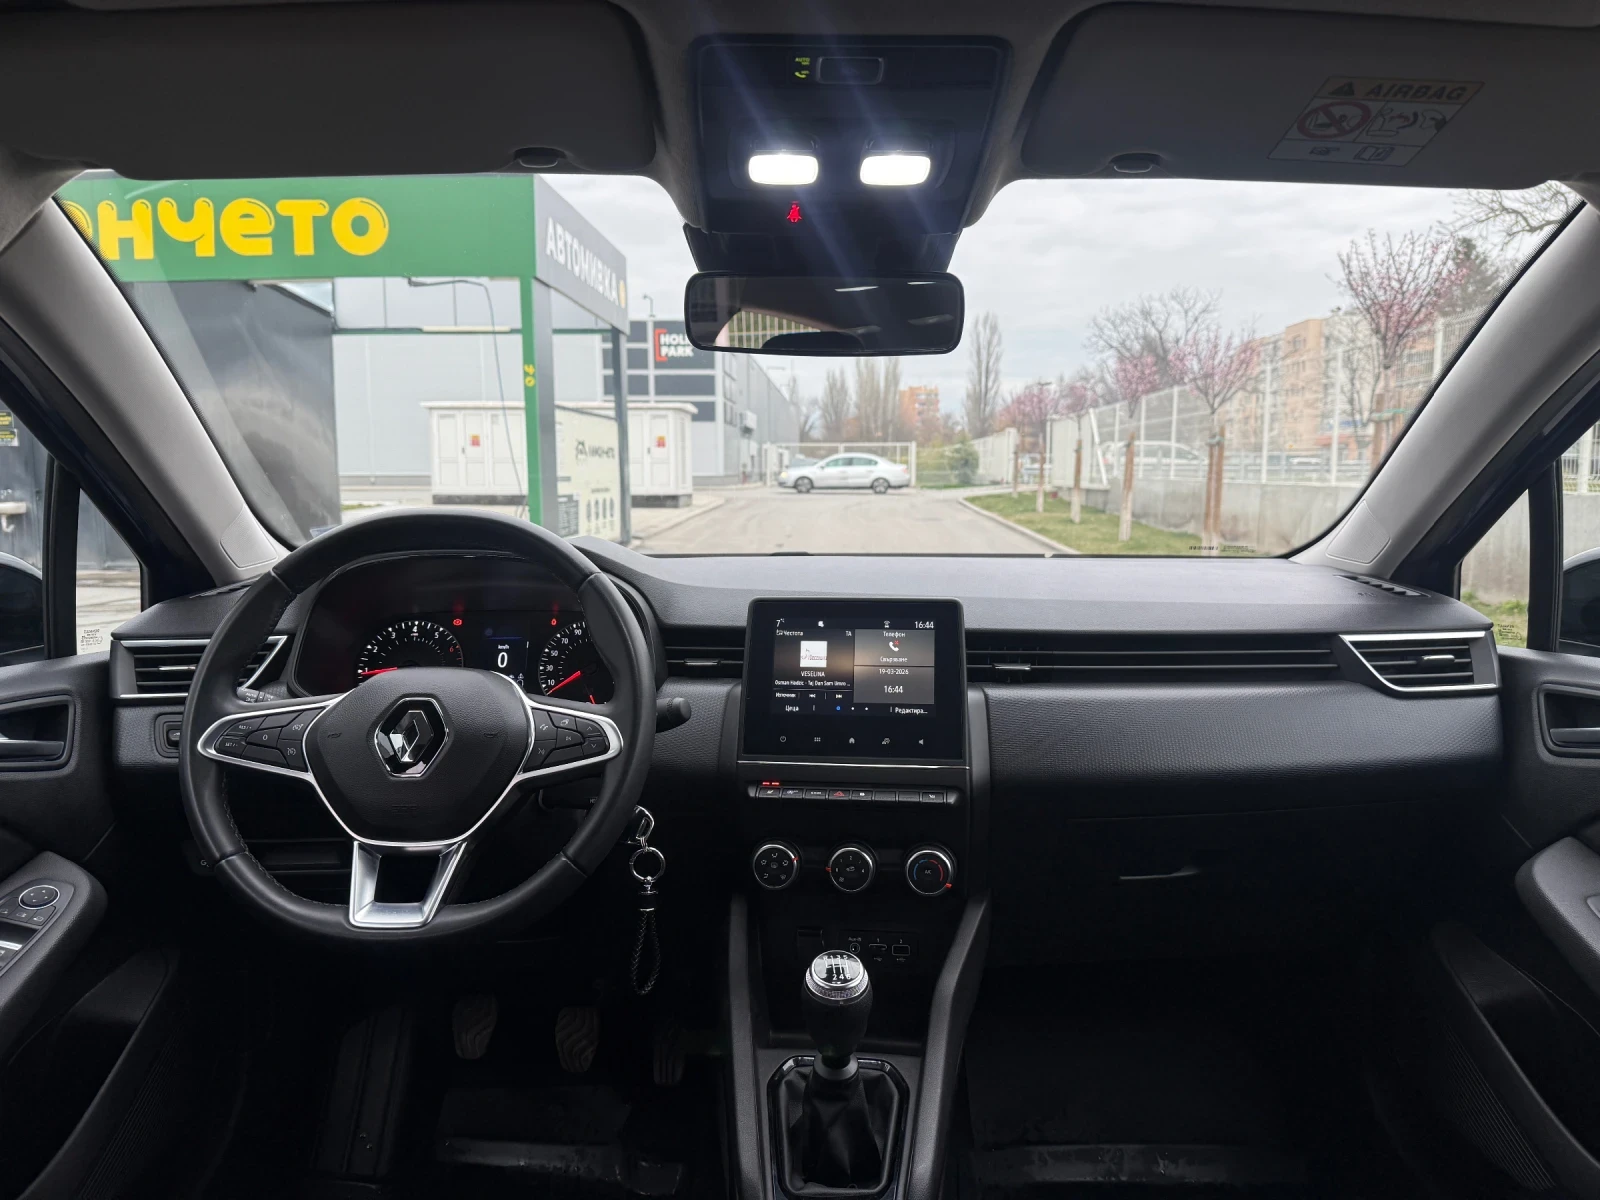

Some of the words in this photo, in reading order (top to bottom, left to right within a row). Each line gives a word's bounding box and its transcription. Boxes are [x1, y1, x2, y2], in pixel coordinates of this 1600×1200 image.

[1365, 83, 1467, 100] AIRBAG
[61, 197, 389, 260] нчето
[660, 346, 694, 357] PARK
[914, 621, 934, 629] 16:44
[497, 652, 508, 668] 0
[884, 685, 903, 693] 16:44
